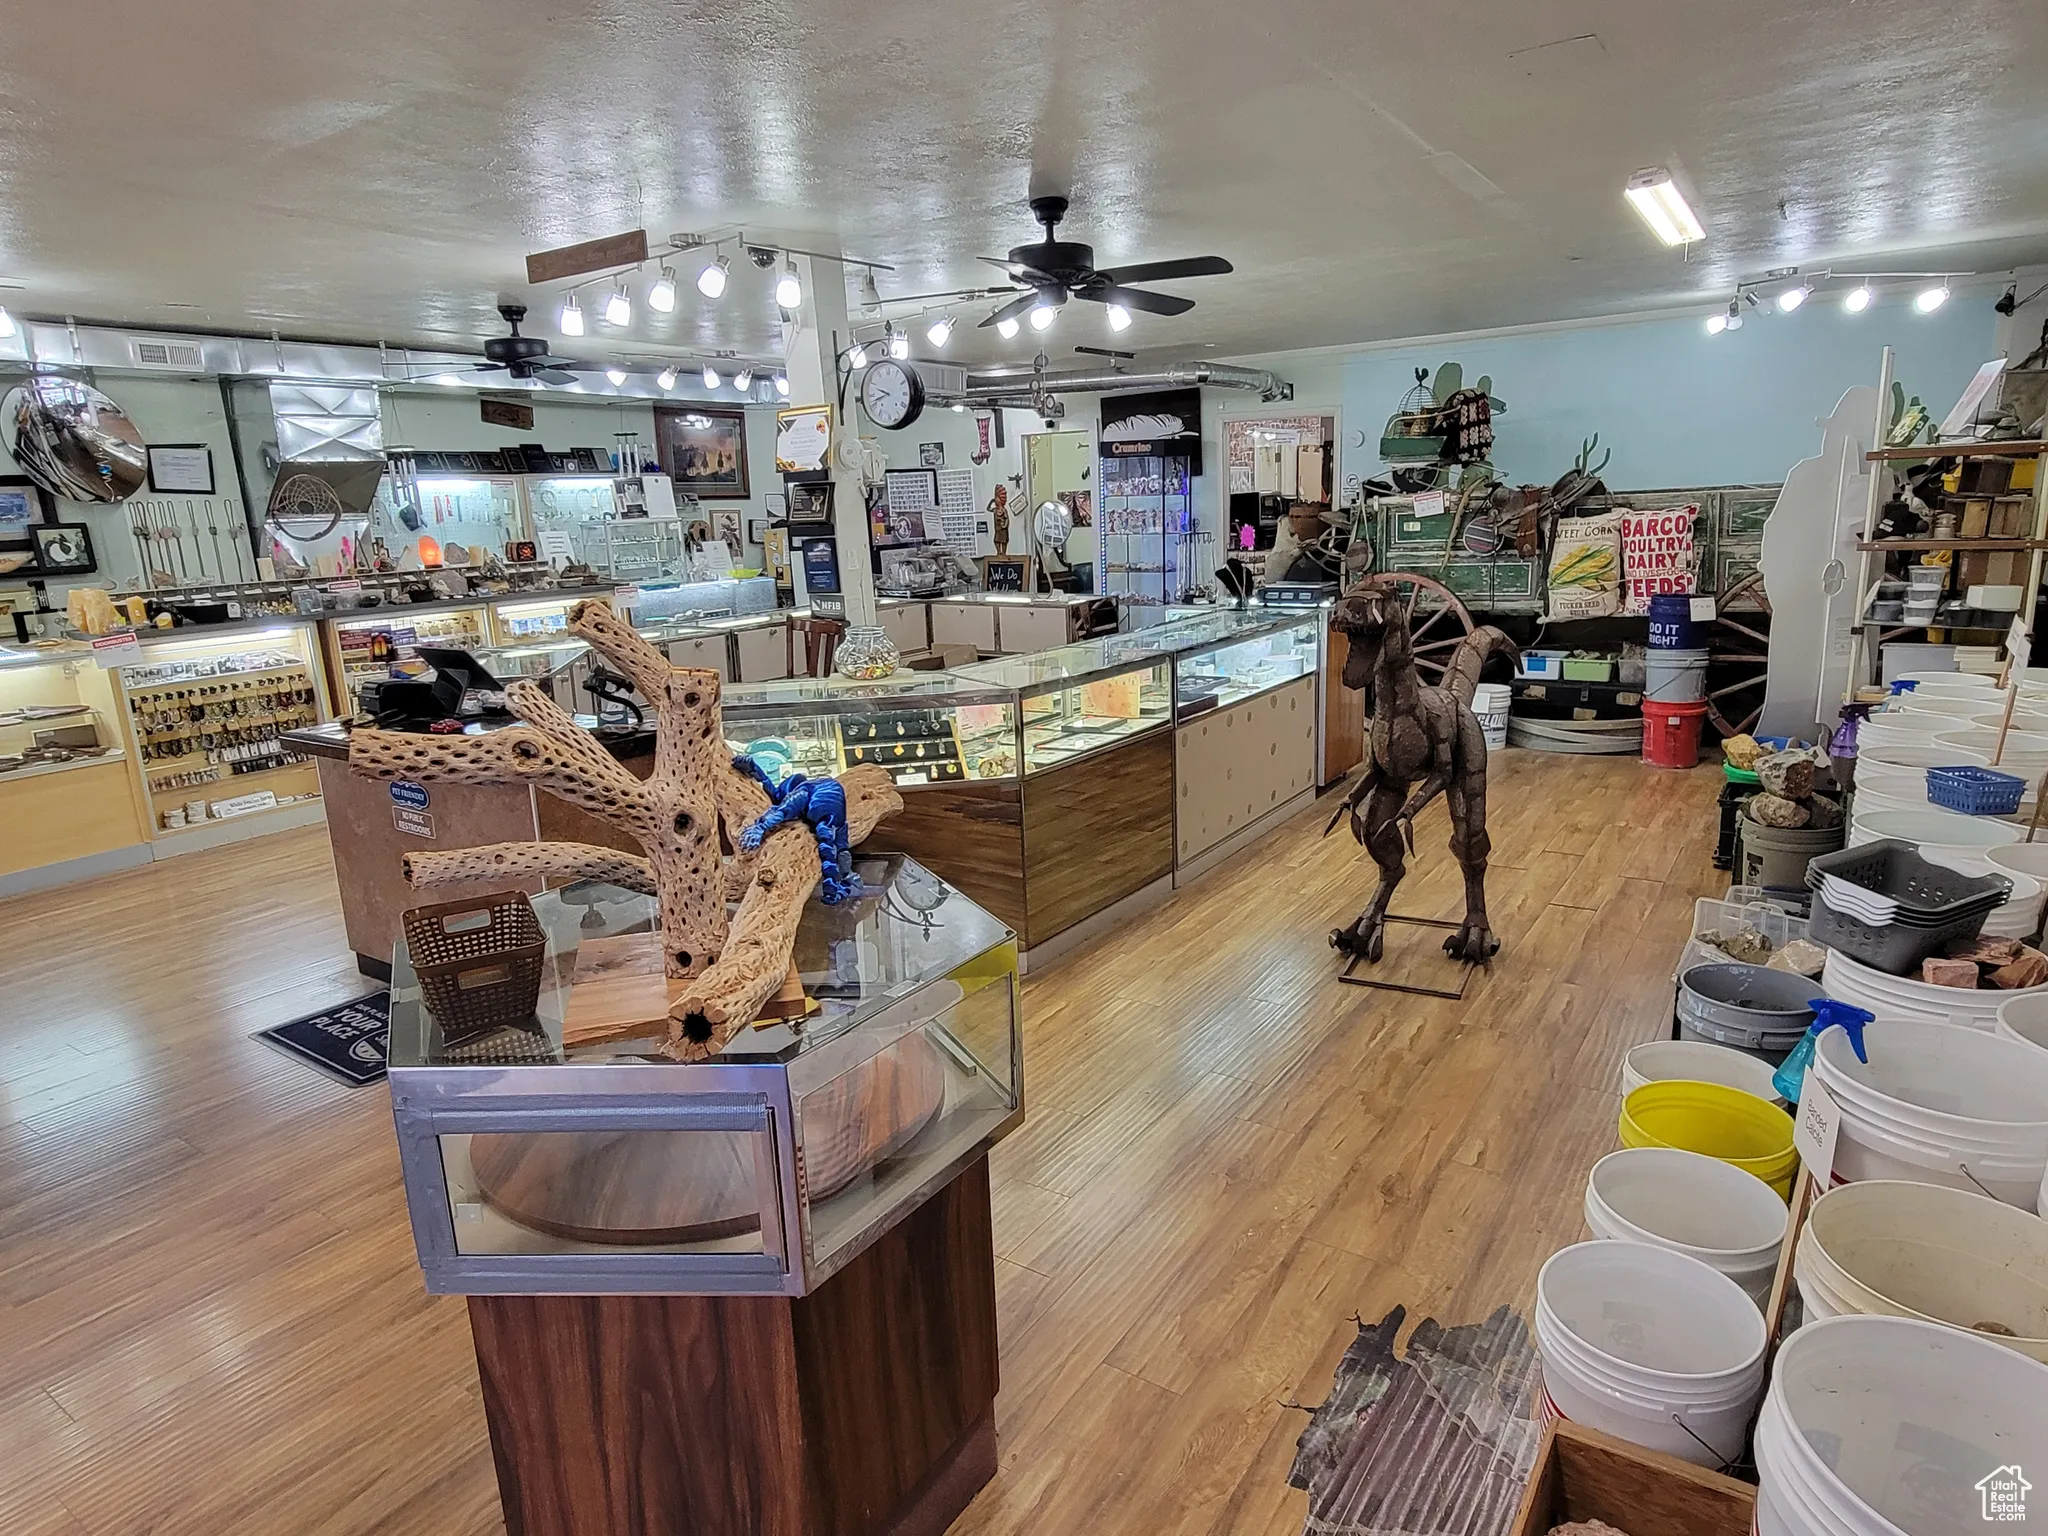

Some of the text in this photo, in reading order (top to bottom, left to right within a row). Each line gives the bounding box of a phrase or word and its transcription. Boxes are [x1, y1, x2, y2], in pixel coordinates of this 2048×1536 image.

[1622, 514, 1688, 538] BARCO
[1628, 552, 1679, 570] DAIRY
[990, 566, 1019, 581] We Do
[1626, 575, 1687, 598] FEEDS
[821, 601, 842, 611] NFIB
[1559, 601, 1583, 610] TUCKER
[1649, 622, 1680, 636] DO IT
[1648, 633, 1679, 646] RIGHT
[398, 820, 432, 836] RESTROOMS
[308, 1016, 361, 1040] PLACE
[333, 1008, 382, 1032] YOUR
